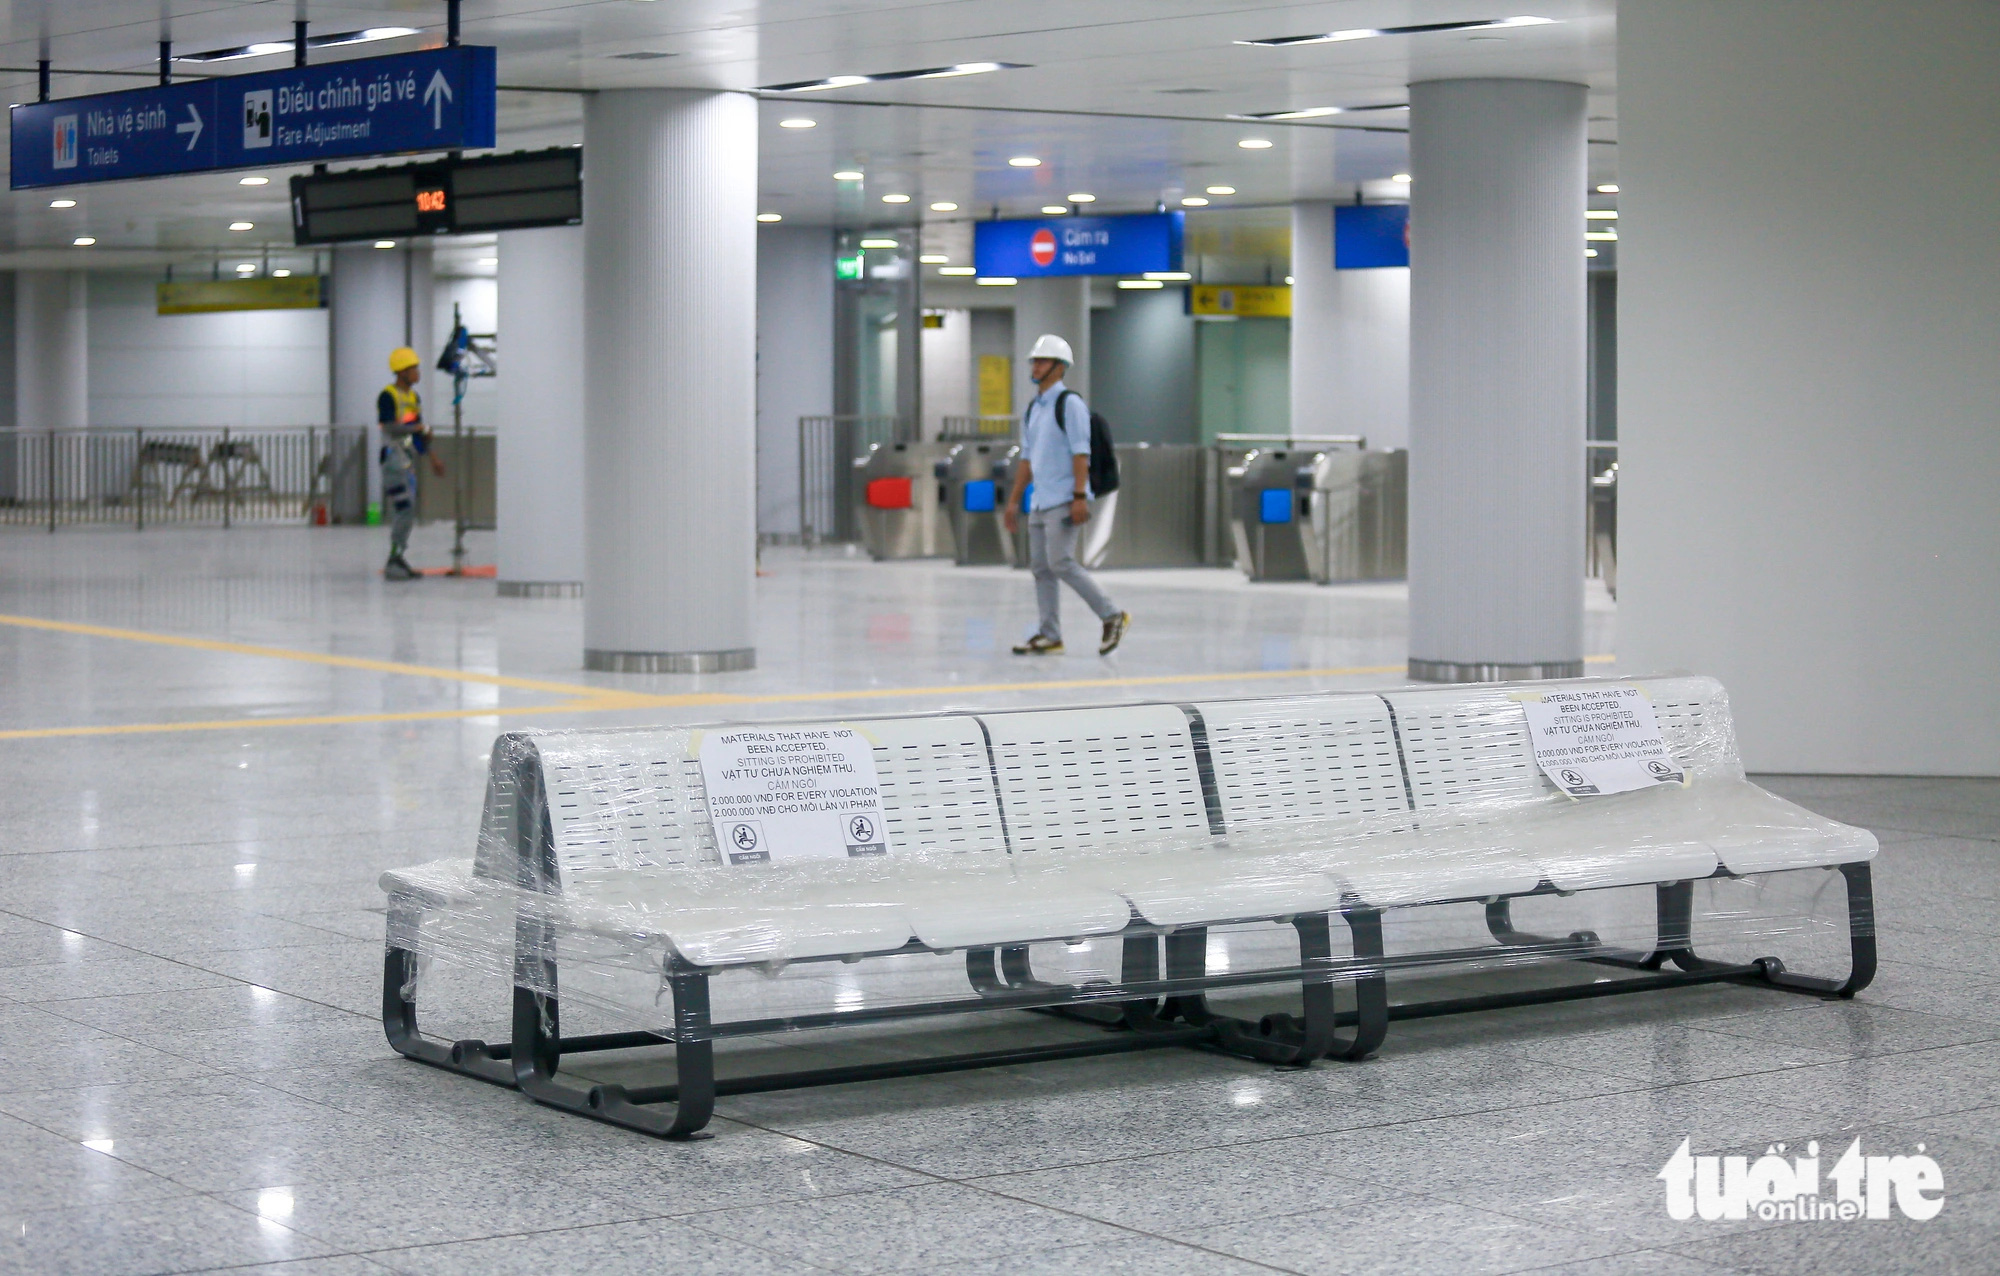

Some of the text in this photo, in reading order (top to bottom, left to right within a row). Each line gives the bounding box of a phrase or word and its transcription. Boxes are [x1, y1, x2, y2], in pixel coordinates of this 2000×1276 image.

[278, 70, 416, 114] Điều chỉnh giá vé
[87, 104, 166, 138] Nhà vệ sinh
[278, 119, 370, 147] Fare Adjustment
[88, 148, 118, 166] Toilets
[1582, 692, 1600, 700] THAT
[1560, 704, 1579, 712] BEEN
[1554, 711, 1633, 724] SITTING IS PROHIBITED
[1572, 724, 1594, 733] CHƯA
[721, 730, 853, 744] MATERIALS THAT HAVE NOT
[747, 745, 773, 754] BEEN
[1537, 748, 1568, 758] 2.000.000
[1585, 745, 1600, 753] FOR
[1601, 742, 1624, 751] EVERY
[1625, 738, 1662, 748] VIOLATION
[737, 753, 844, 767] SITTING IS PROHIBITED
[1541, 758, 1572, 767] 2.000.000
[1589, 755, 1605, 763] CHO
[722, 769, 741, 781] VẬT
[744, 768, 758, 778] TƯ
[761, 766, 790, 777] CHƯA
[792, 764, 831, 776] NGHIỆM
[711, 787, 877, 806] 2.000.000 VND FOR EVERY VIOLATION
[714, 806, 754, 818] 2.000.000
[756, 805, 775, 815] VNĐ
[778, 804, 798, 814] CHO
[840, 800, 849, 809] VI
[850, 799, 877, 810] PHẠM
